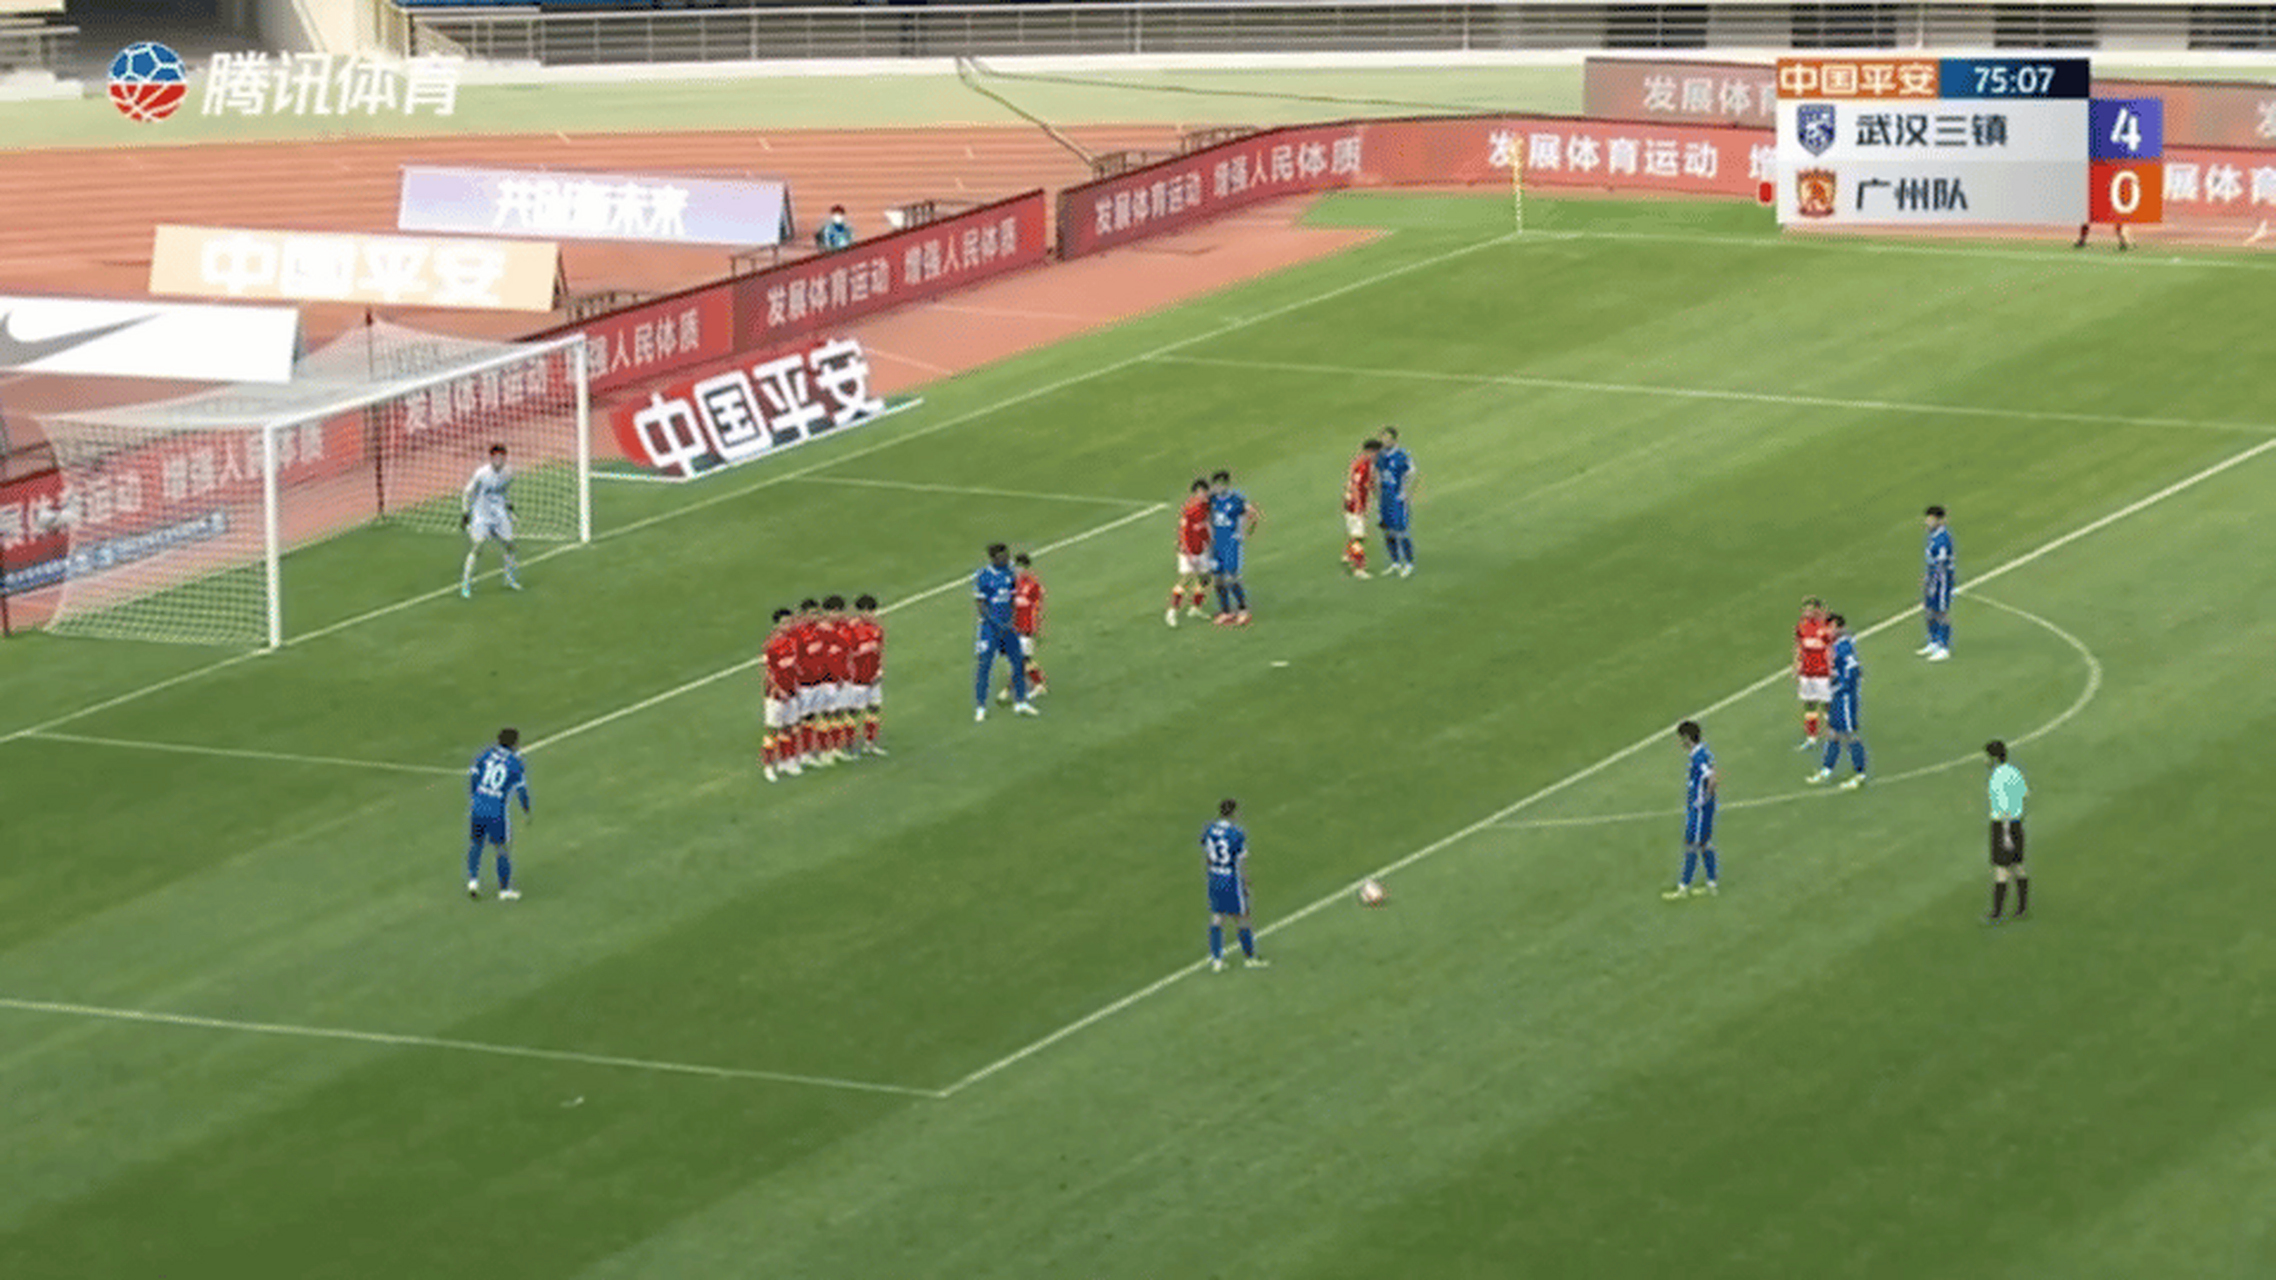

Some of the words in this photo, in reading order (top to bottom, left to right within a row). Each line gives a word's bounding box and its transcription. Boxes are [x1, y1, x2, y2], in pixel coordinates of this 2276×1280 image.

[1095, 170, 1201, 236] 发展体育运动
[1213, 136, 1362, 198] 增强人民体质
[1488, 131, 1719, 179] 发展体育运动
[202, 232, 506, 304] 中国平安
[766, 256, 890, 328] 发展体育运动
[633, 337, 887, 477] 中国平安
[482, 760, 507, 790] 10
